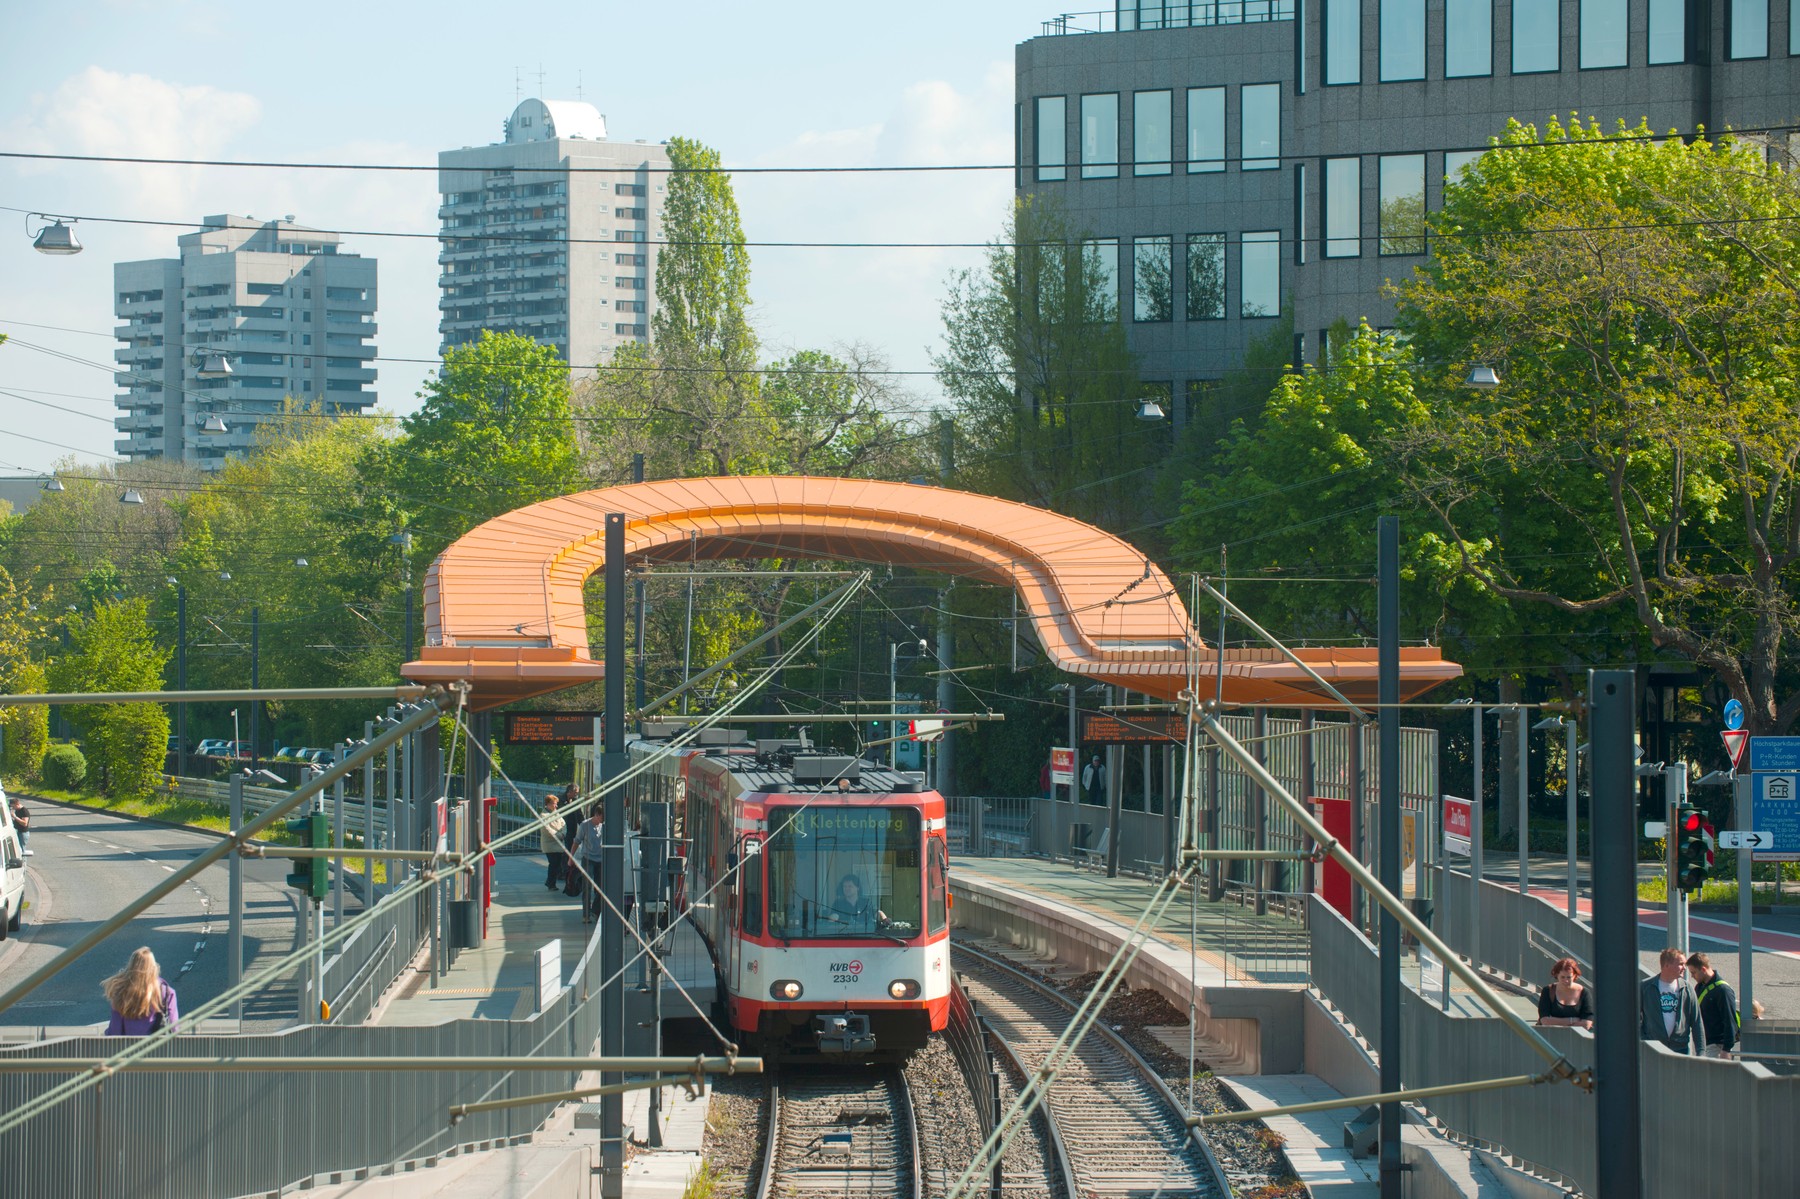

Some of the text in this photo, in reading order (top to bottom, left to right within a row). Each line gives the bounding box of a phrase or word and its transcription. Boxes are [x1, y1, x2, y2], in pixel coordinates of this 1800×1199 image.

[810, 814, 903, 831] Klettenberg
[830, 963, 849, 972] KVB
[833, 974, 859, 983] 2330
